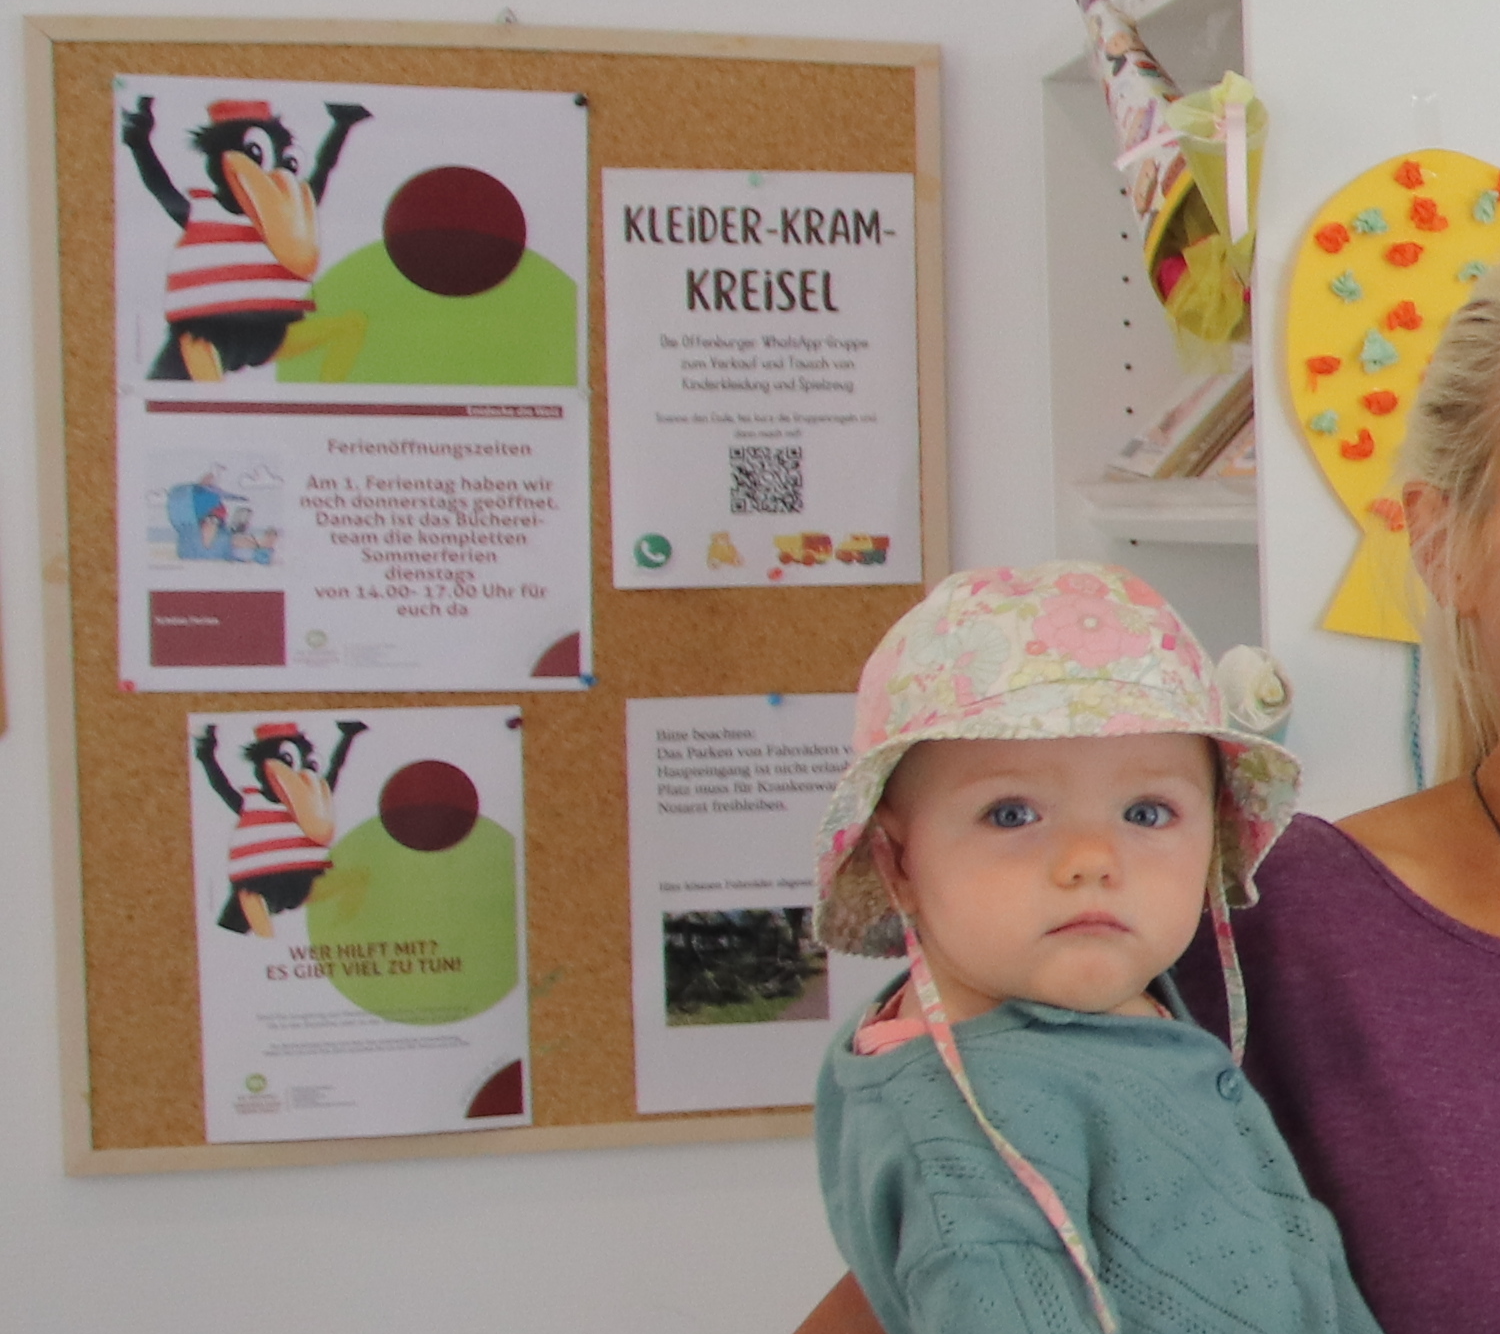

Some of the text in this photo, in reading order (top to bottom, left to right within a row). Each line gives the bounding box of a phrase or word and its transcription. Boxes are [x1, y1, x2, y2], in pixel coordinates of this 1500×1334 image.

[682, 333, 755, 351] Offenburger
[762, 357, 784, 369] und
[774, 377, 795, 391] und
[327, 438, 532, 459] Ferienöffnungszeiten
[307, 475, 553, 494] Am 1. Ferientag haben wir
[300, 494, 559, 513] noch donnerstags geöffnet.
[316, 511, 544, 528] Danach ist das Bücherei-
[330, 529, 527, 548] team die kompletten
[362, 548, 497, 564] Sommerferien
[385, 565, 475, 583] dienstags
[315, 583, 546, 599] von 14.00- 17.00 Uhr für
[397, 601, 468, 617] euch da
[657, 744, 838, 760] Das Parken von Fahrrädern
[755, 764, 770, 776] ist
[774, 763, 807, 776] nicht
[289, 939, 438, 961] WER HILFT MIT?
[267, 957, 462, 980] ES GIBT VIEL ZU TUN!
